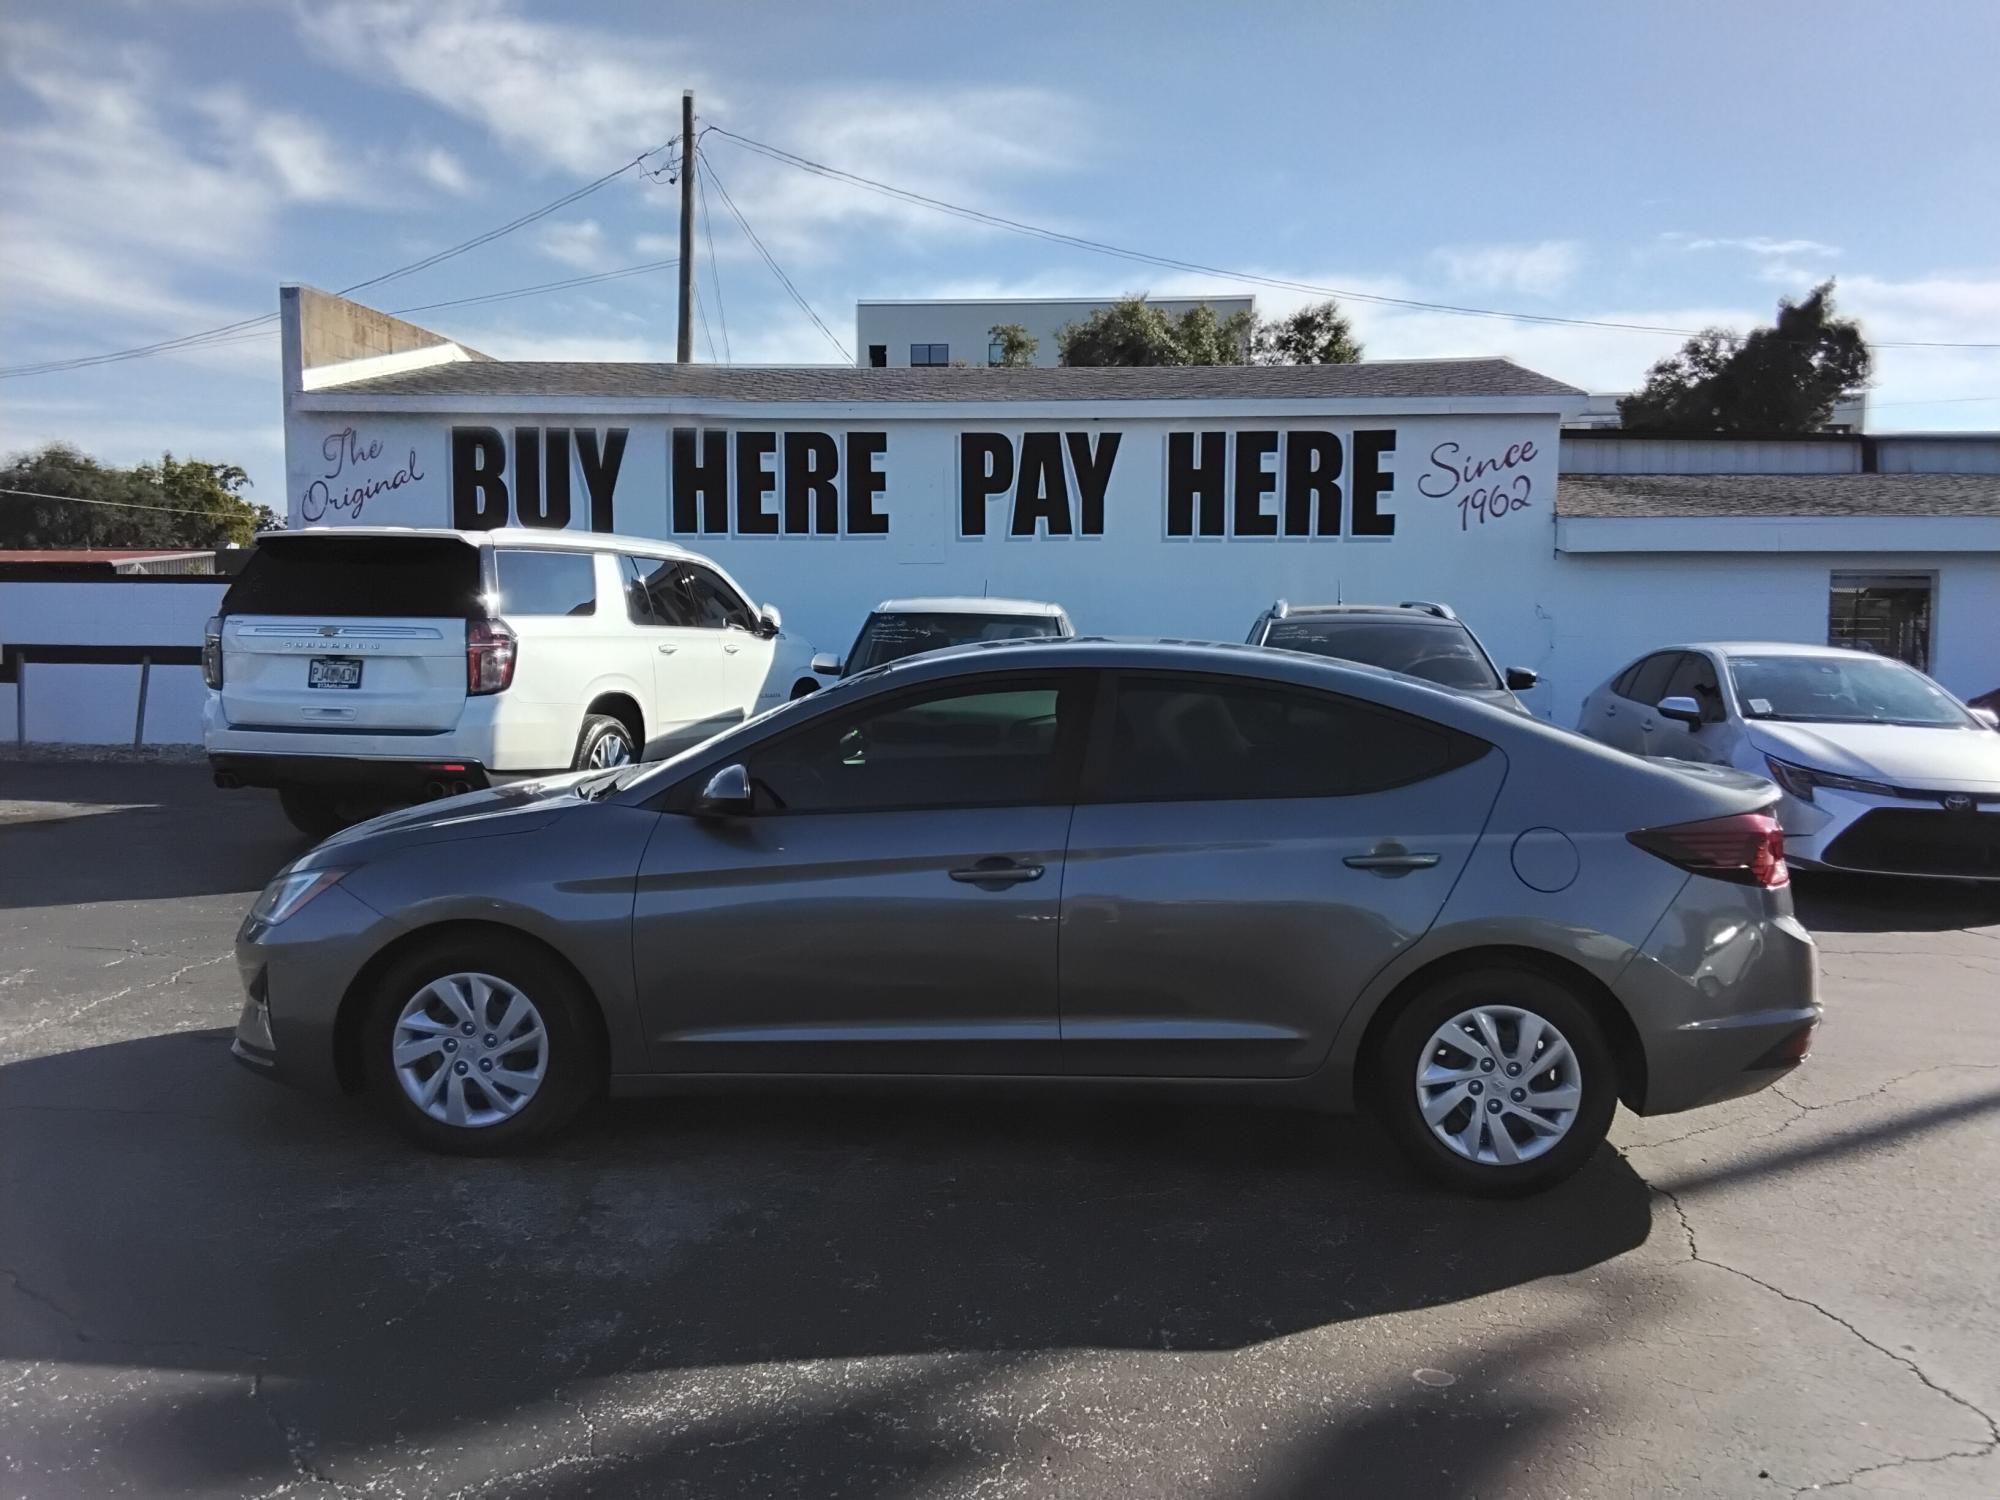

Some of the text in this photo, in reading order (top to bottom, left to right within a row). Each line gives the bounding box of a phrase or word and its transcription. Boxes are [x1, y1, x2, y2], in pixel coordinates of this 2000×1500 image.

[322, 427, 384, 479] The
[1418, 440, 1539, 498] Since
[302, 451, 424, 522] Original
[450, 426, 1396, 540] BUY HERE PAY HERE
[1458, 474, 1532, 531] 1962
